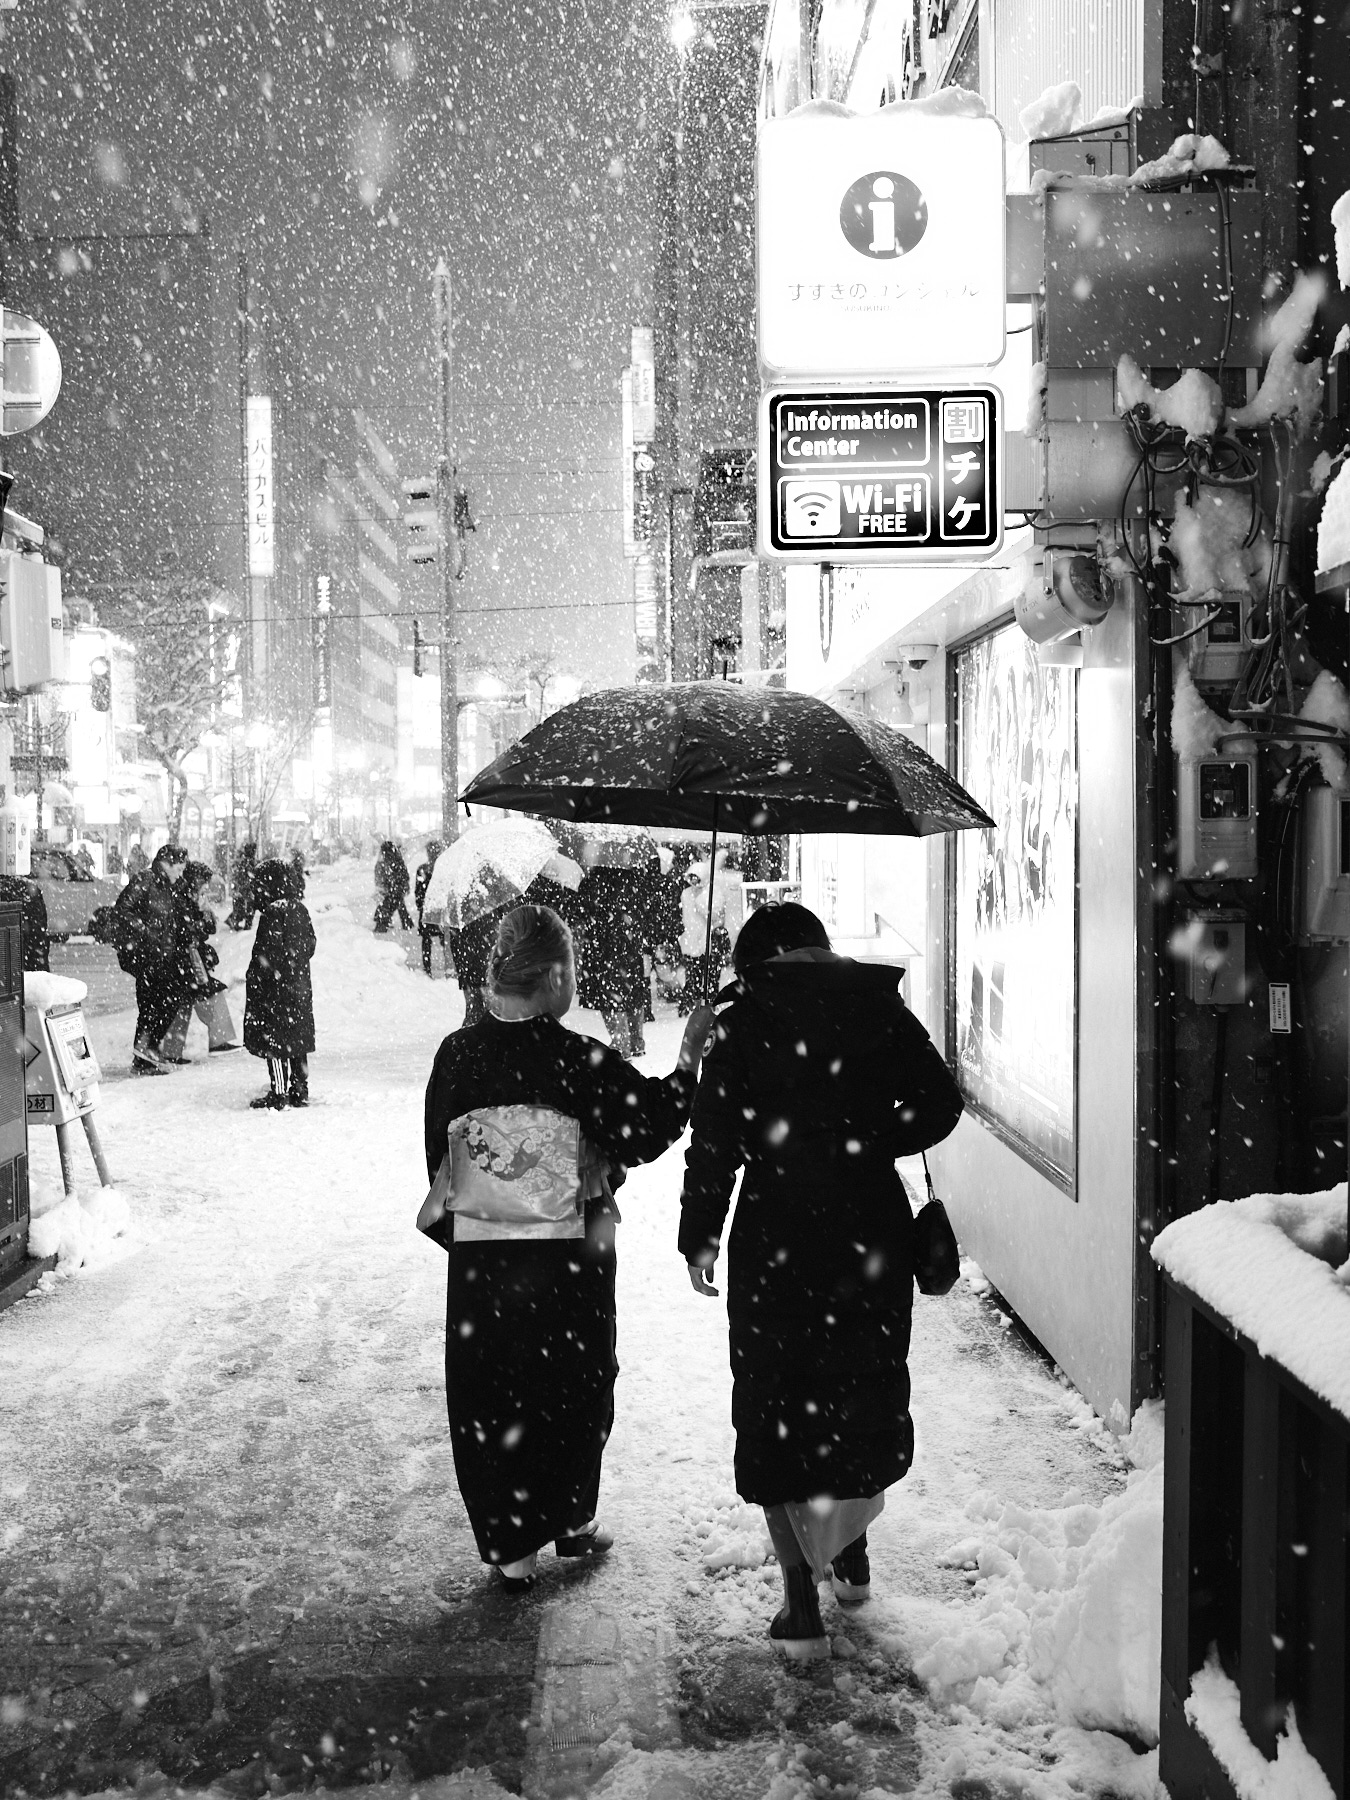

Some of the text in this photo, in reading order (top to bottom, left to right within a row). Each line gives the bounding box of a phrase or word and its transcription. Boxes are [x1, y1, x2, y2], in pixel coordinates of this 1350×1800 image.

[787, 409, 918, 432] Information
[787, 436, 860, 457] Center
[947, 406, 981, 531] 割チケ
[842, 482, 922, 514] Wi-Fi
[858, 514, 907, 534] FREE
